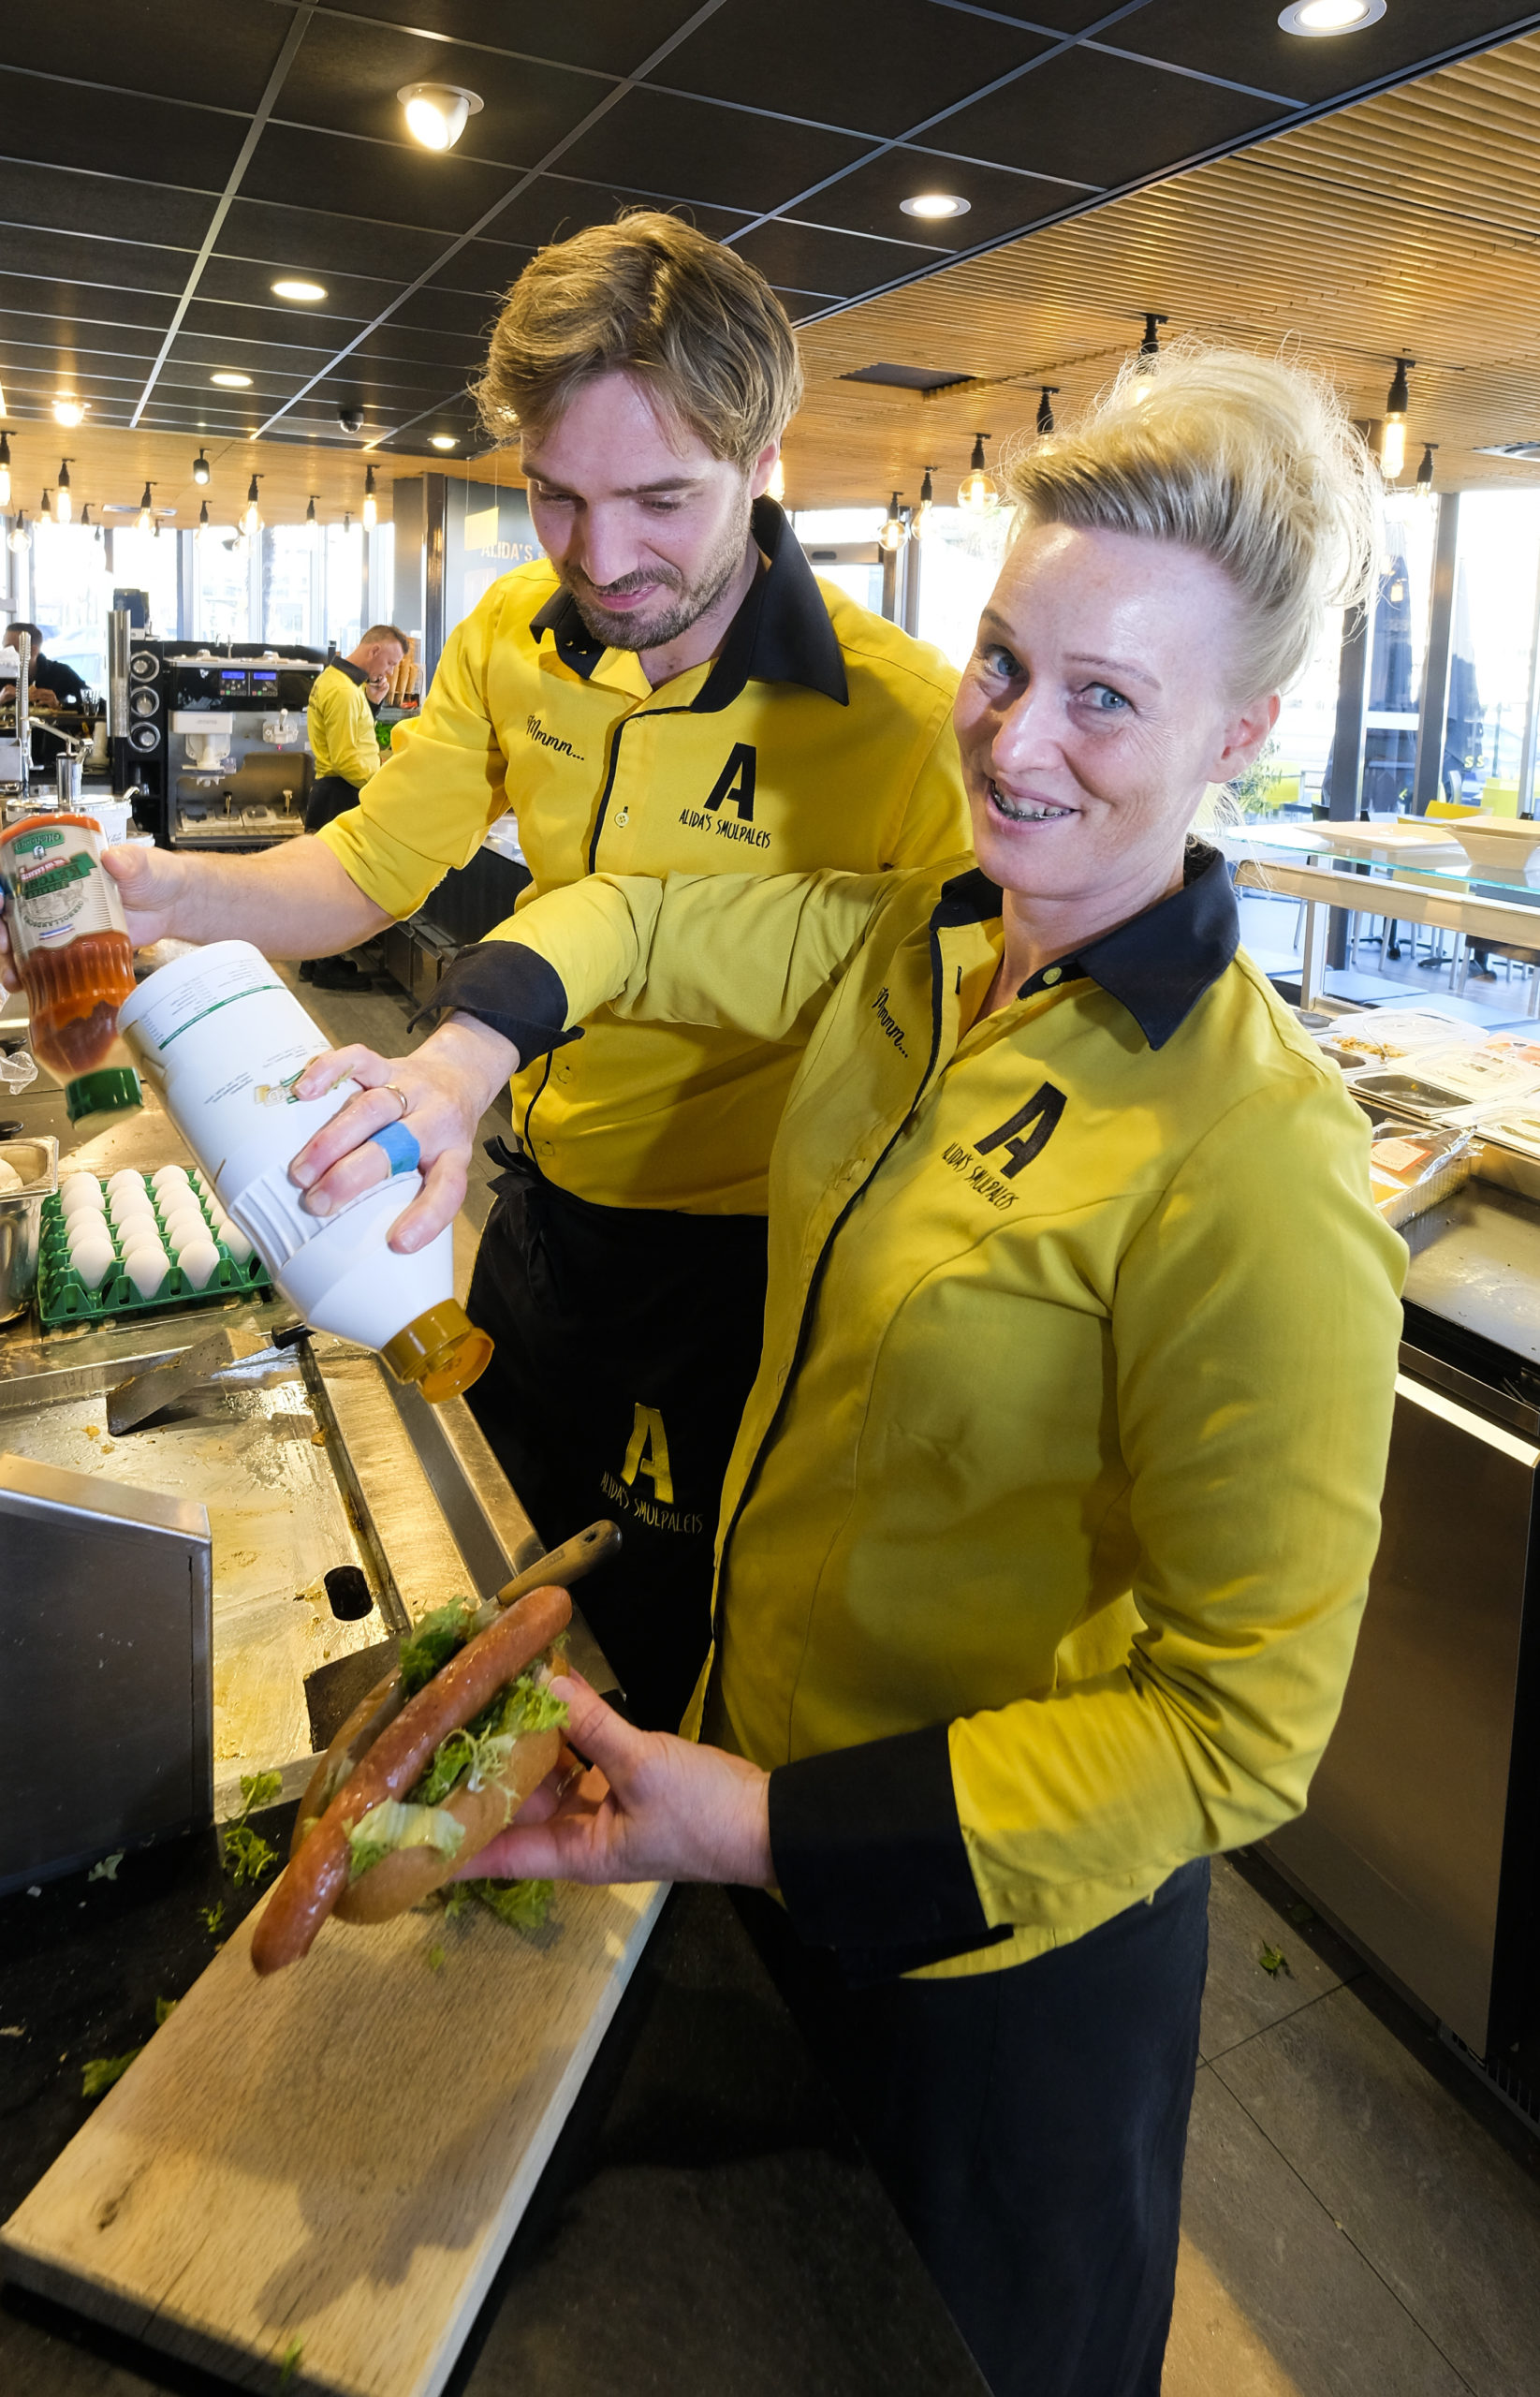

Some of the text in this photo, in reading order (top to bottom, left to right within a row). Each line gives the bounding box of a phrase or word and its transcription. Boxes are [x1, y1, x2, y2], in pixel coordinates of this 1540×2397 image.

[703, 742, 756, 822] A
[679, 808, 772, 849] ALIDA'S SMULPALEIS
[974, 1081, 1068, 1180] A
[620, 1402, 674, 1504] A
[600, 1470, 703, 1535] ALIDA'S SMULPALEIS
